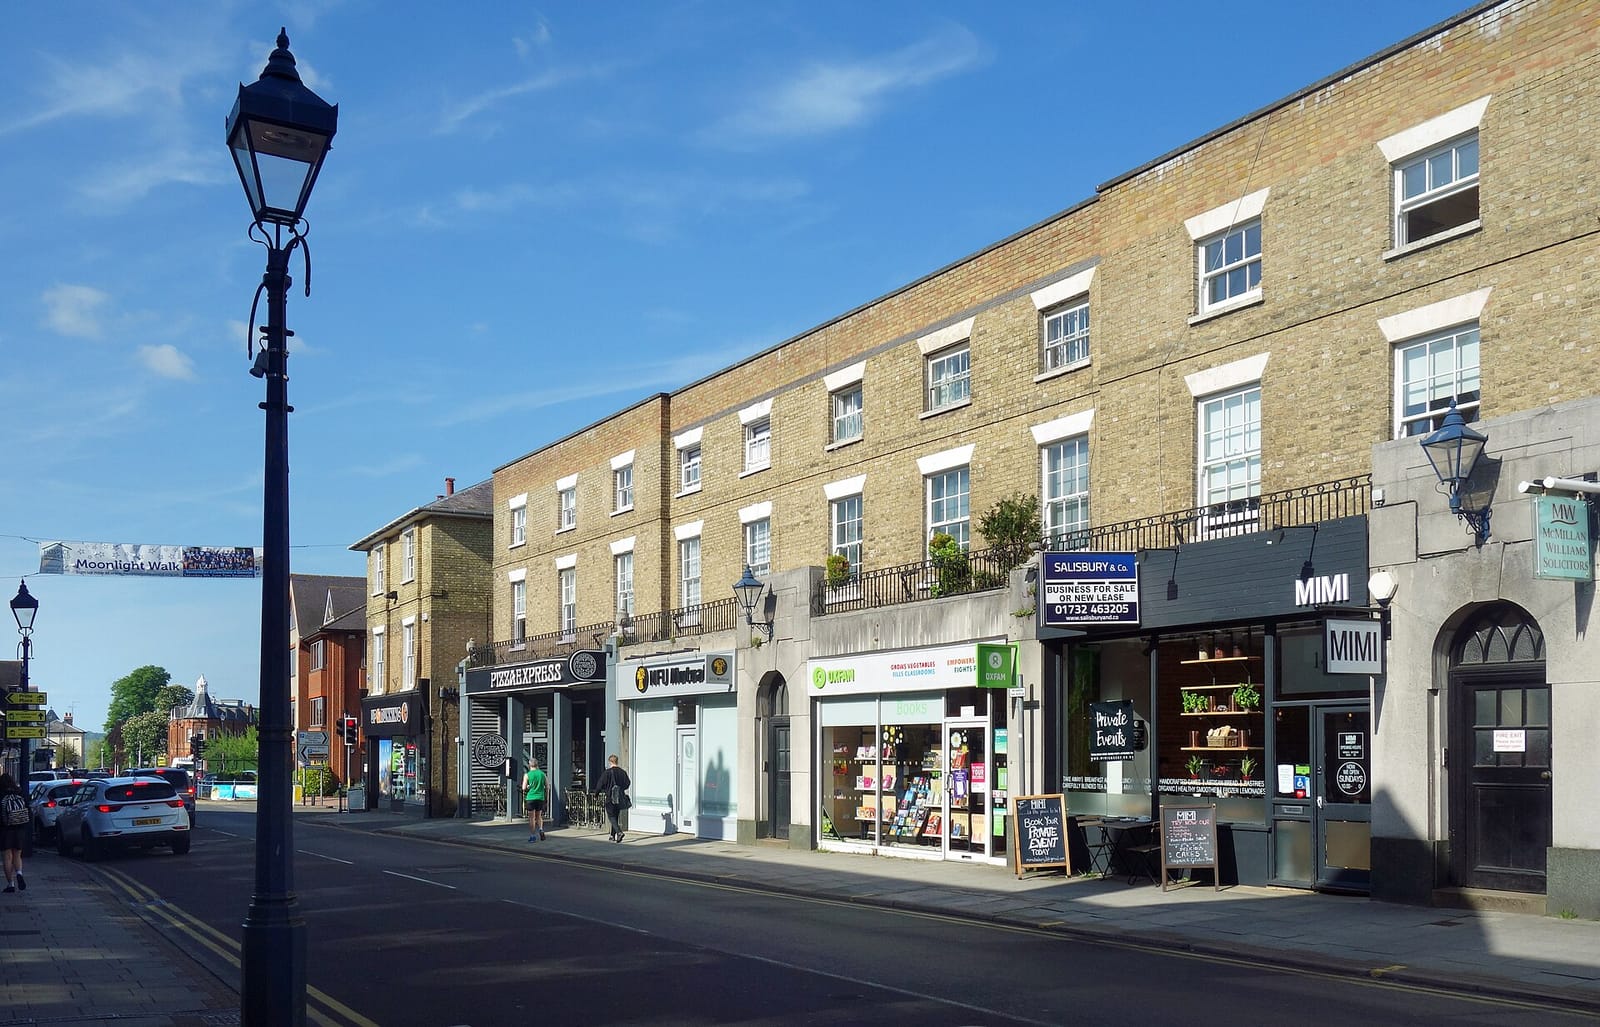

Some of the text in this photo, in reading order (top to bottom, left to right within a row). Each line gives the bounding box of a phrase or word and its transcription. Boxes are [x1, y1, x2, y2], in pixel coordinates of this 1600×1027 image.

[1552, 503, 1576, 520] MW
[1545, 542, 1587, 556] WILLIAMS
[76, 558, 180, 573] Moonlight Walk
[1054, 562, 1129, 572] SALISBURY & Co.
[1543, 557, 1589, 571] SOLICITORS
[1047, 584, 1136, 594] BUSINESS FOR SALE
[1295, 573, 1350, 607] MIMI
[1059, 593, 1124, 602] OR NEW LEASE
[1055, 604, 1129, 614] 01732 463205
[1330, 630, 1377, 662] MIMI
[907, 661, 936, 669] VEGETABLES
[946, 657, 975, 666] EMPOWERS
[905, 669, 935, 677] CLASSROOMS
[954, 665, 972, 673] FIGHTS
[490, 663, 562, 688] PIZZAEXPRESS
[649, 664, 705, 687] NFU Mutual
[828, 669, 855, 684] OXFAM
[985, 673, 1006, 681] OXFAM
[1096, 708, 1128, 728] Private
[1096, 728, 1127, 747] Events
[1338, 775, 1363, 783] SUNDAYS
[1178, 785, 1196, 793] HEALTHY
[1240, 787, 1266, 795] LEMONADES
[1176, 811, 1196, 820] MIMI
[1028, 826, 1058, 839] PRIVATE
[1028, 837, 1059, 849] EVENT
[1031, 848, 1050, 856] TODAY
[1175, 851, 1201, 859] CAKES
